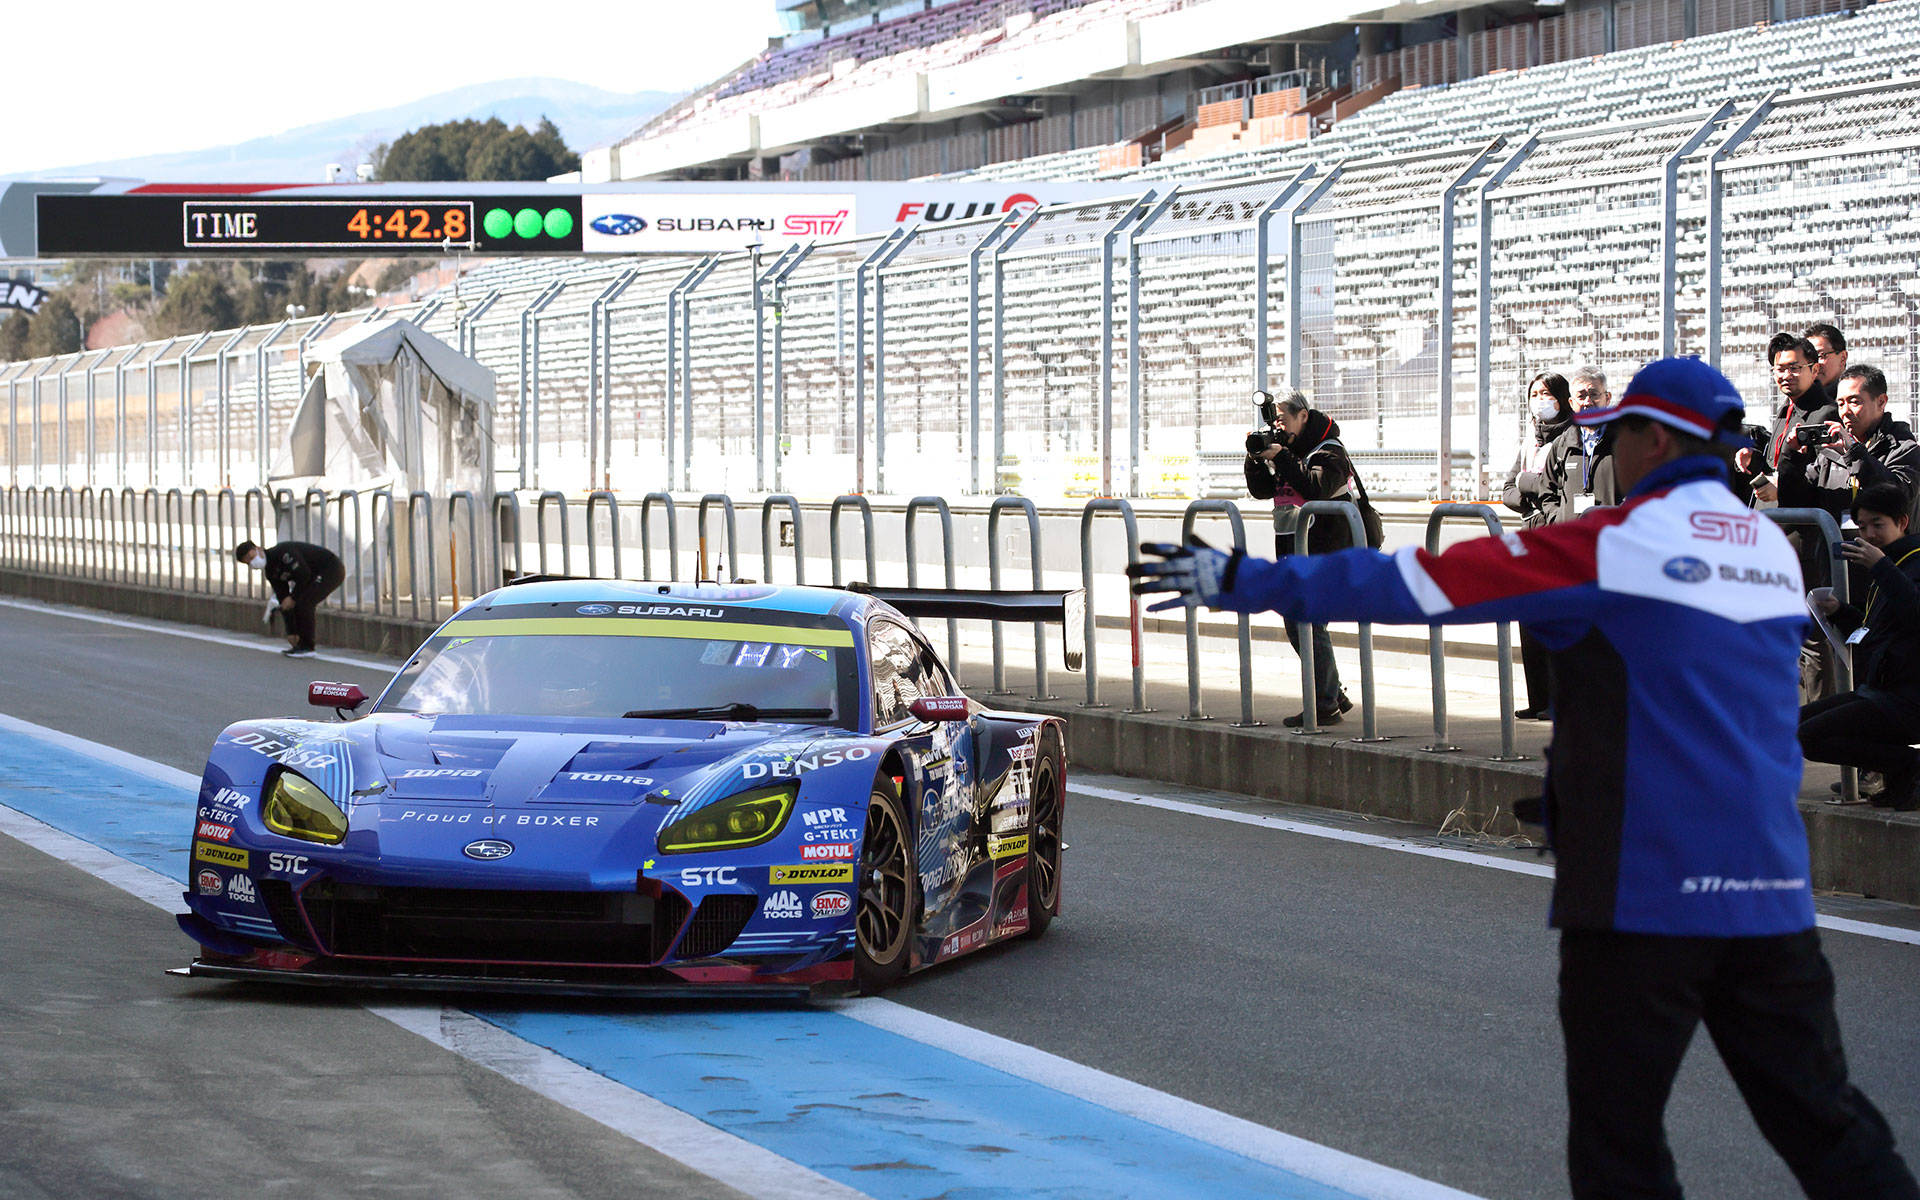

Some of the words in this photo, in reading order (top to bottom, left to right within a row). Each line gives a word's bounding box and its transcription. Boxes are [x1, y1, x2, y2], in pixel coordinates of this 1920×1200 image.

[896, 202, 996, 222] FUJI
[191, 212, 258, 238] TIME
[347, 208, 467, 239] 4:42.8
[656, 217, 776, 232] SUBARU
[1718, 563, 1799, 593] SUBARU
[616, 605, 725, 619] SUBARU
[229, 732, 339, 769] DENSO
[742, 746, 871, 779] DENSO
[213, 787, 251, 810] NPR
[199, 806, 239, 824] G-TEKT
[400, 810, 472, 824] Proud
[482, 814, 507, 825] of
[516, 815, 600, 828] BOXER
[802, 808, 848, 826] NPR
[199, 823, 231, 840] MOTUL
[804, 829, 858, 842] G-TEKT
[205, 848, 245, 862] DUNLOP
[803, 845, 852, 859] MOTUL
[997, 840, 1028, 853] DUNLOP
[269, 852, 309, 875] STC
[201, 875, 220, 889] BMC
[681, 866, 738, 886] STC
[787, 868, 849, 879] DUNLOP
[228, 873, 255, 896] MAC
[1680, 876, 1722, 894] STI
[228, 891, 256, 904] TOOLS
[762, 890, 803, 911] MAC
[815, 897, 848, 910] BMC
[763, 910, 803, 919] TOOLS
